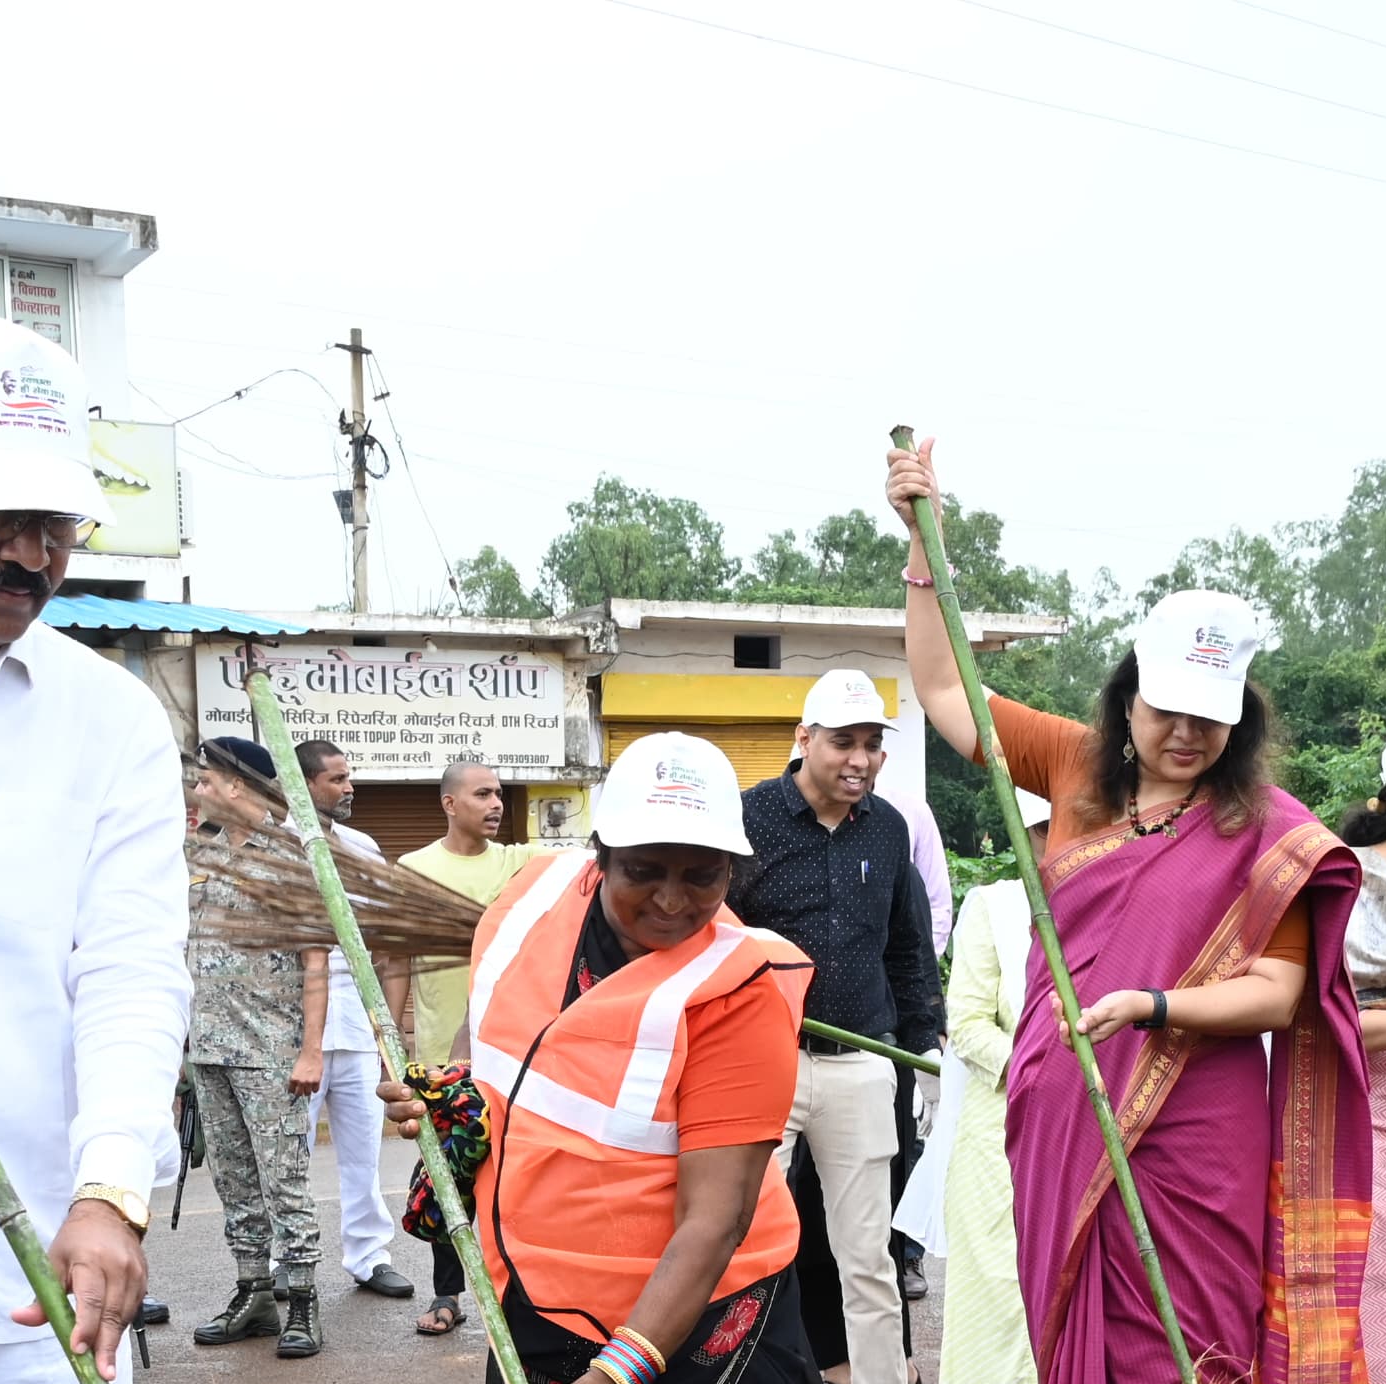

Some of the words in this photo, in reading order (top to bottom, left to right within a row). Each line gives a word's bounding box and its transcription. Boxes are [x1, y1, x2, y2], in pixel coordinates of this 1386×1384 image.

[305, 648, 464, 702] मोबाईल
[468, 655, 551, 701] शॉप
[403, 711, 455, 728] मोबाईल
[501, 714, 521, 728] DTH
[291, 726, 310, 743] एवं
[313, 730, 338, 743] FREE
[339, 730, 362, 744] FIRE
[364, 730, 397, 744] TOPUP
[400, 729, 434, 746] किया
[437, 732, 469, 746] जाता
[471, 731, 483, 747] है
[370, 753, 400, 764] माना
[402, 750, 432, 764] बस्ती
